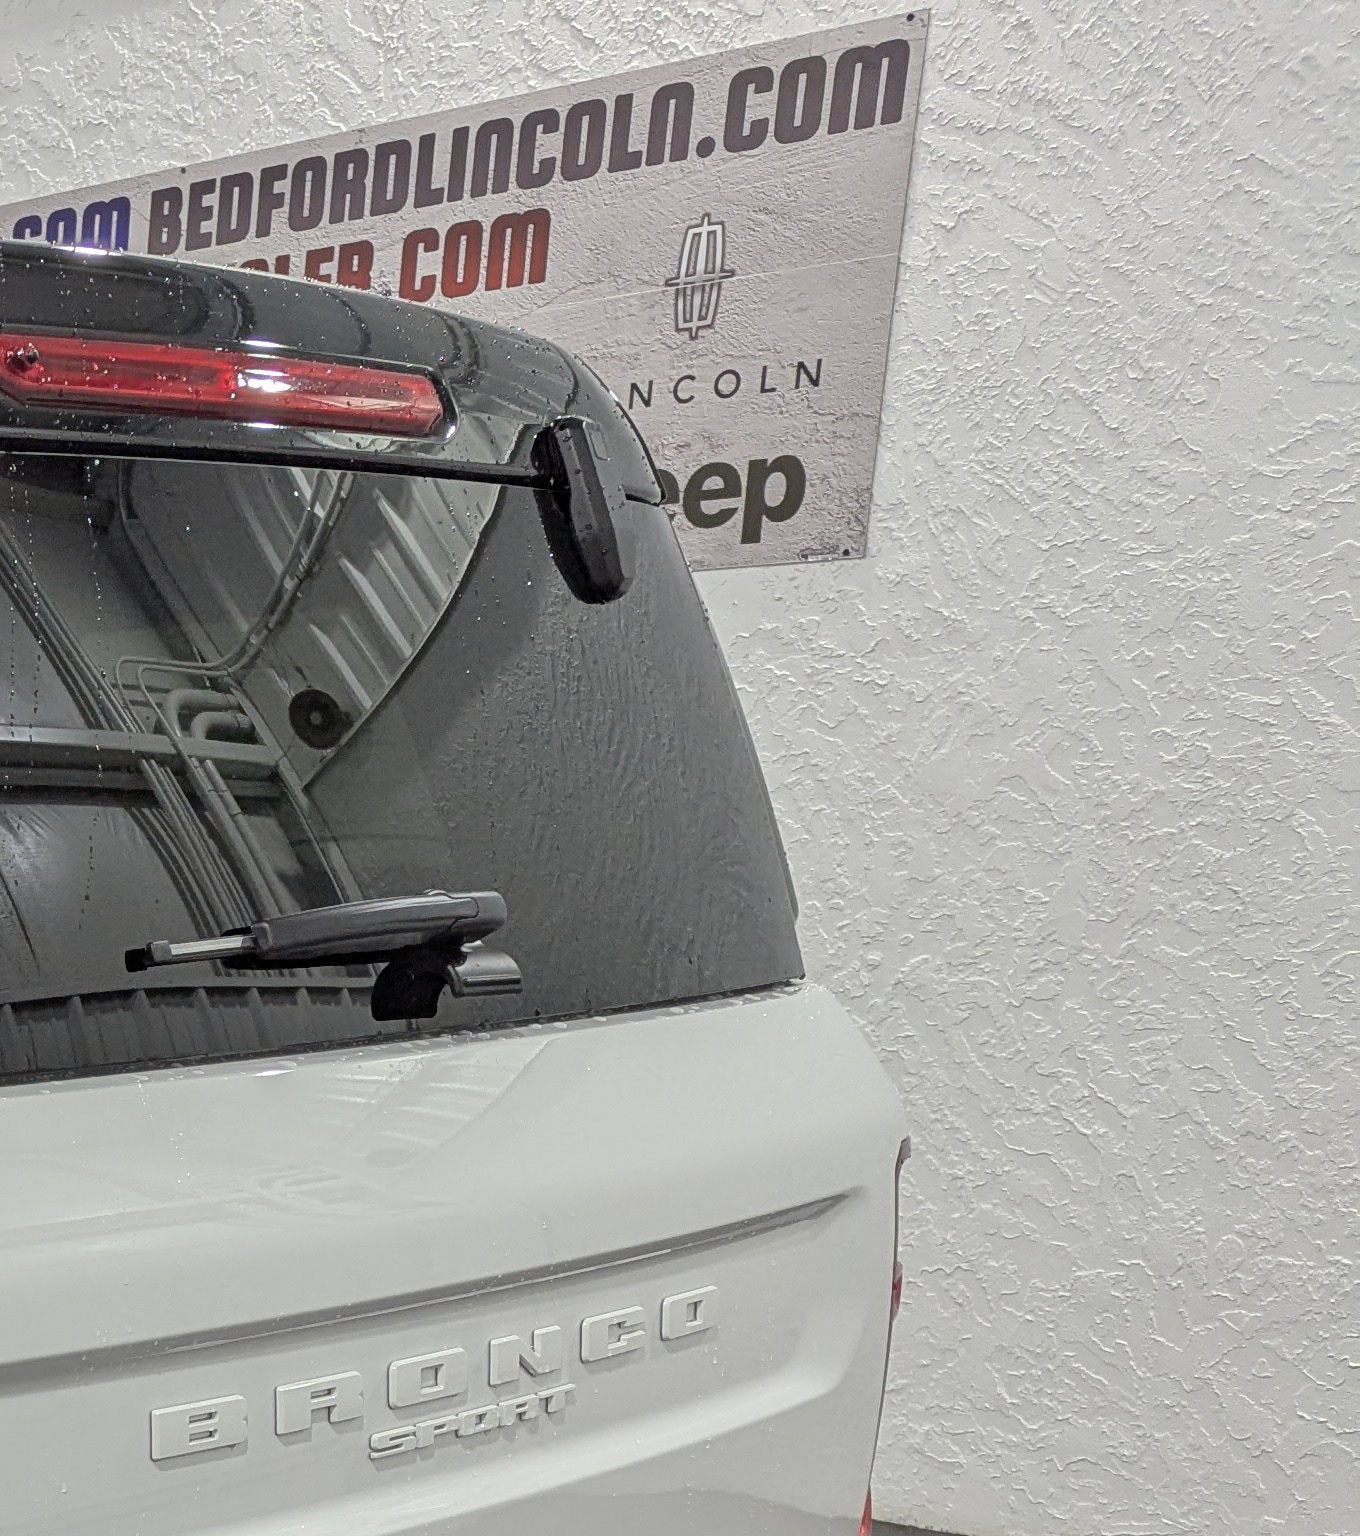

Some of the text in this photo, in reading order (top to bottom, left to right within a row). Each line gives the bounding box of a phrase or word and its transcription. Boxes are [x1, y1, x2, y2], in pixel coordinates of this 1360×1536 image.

[147, 38, 911, 257] BEDFORDLINCOLN.COM
[627, 358, 823, 411] NCOLN
[656, 455, 807, 545] ep
[149, 1285, 720, 1462] BRONCO
[369, 1383, 577, 1461] SPORT
